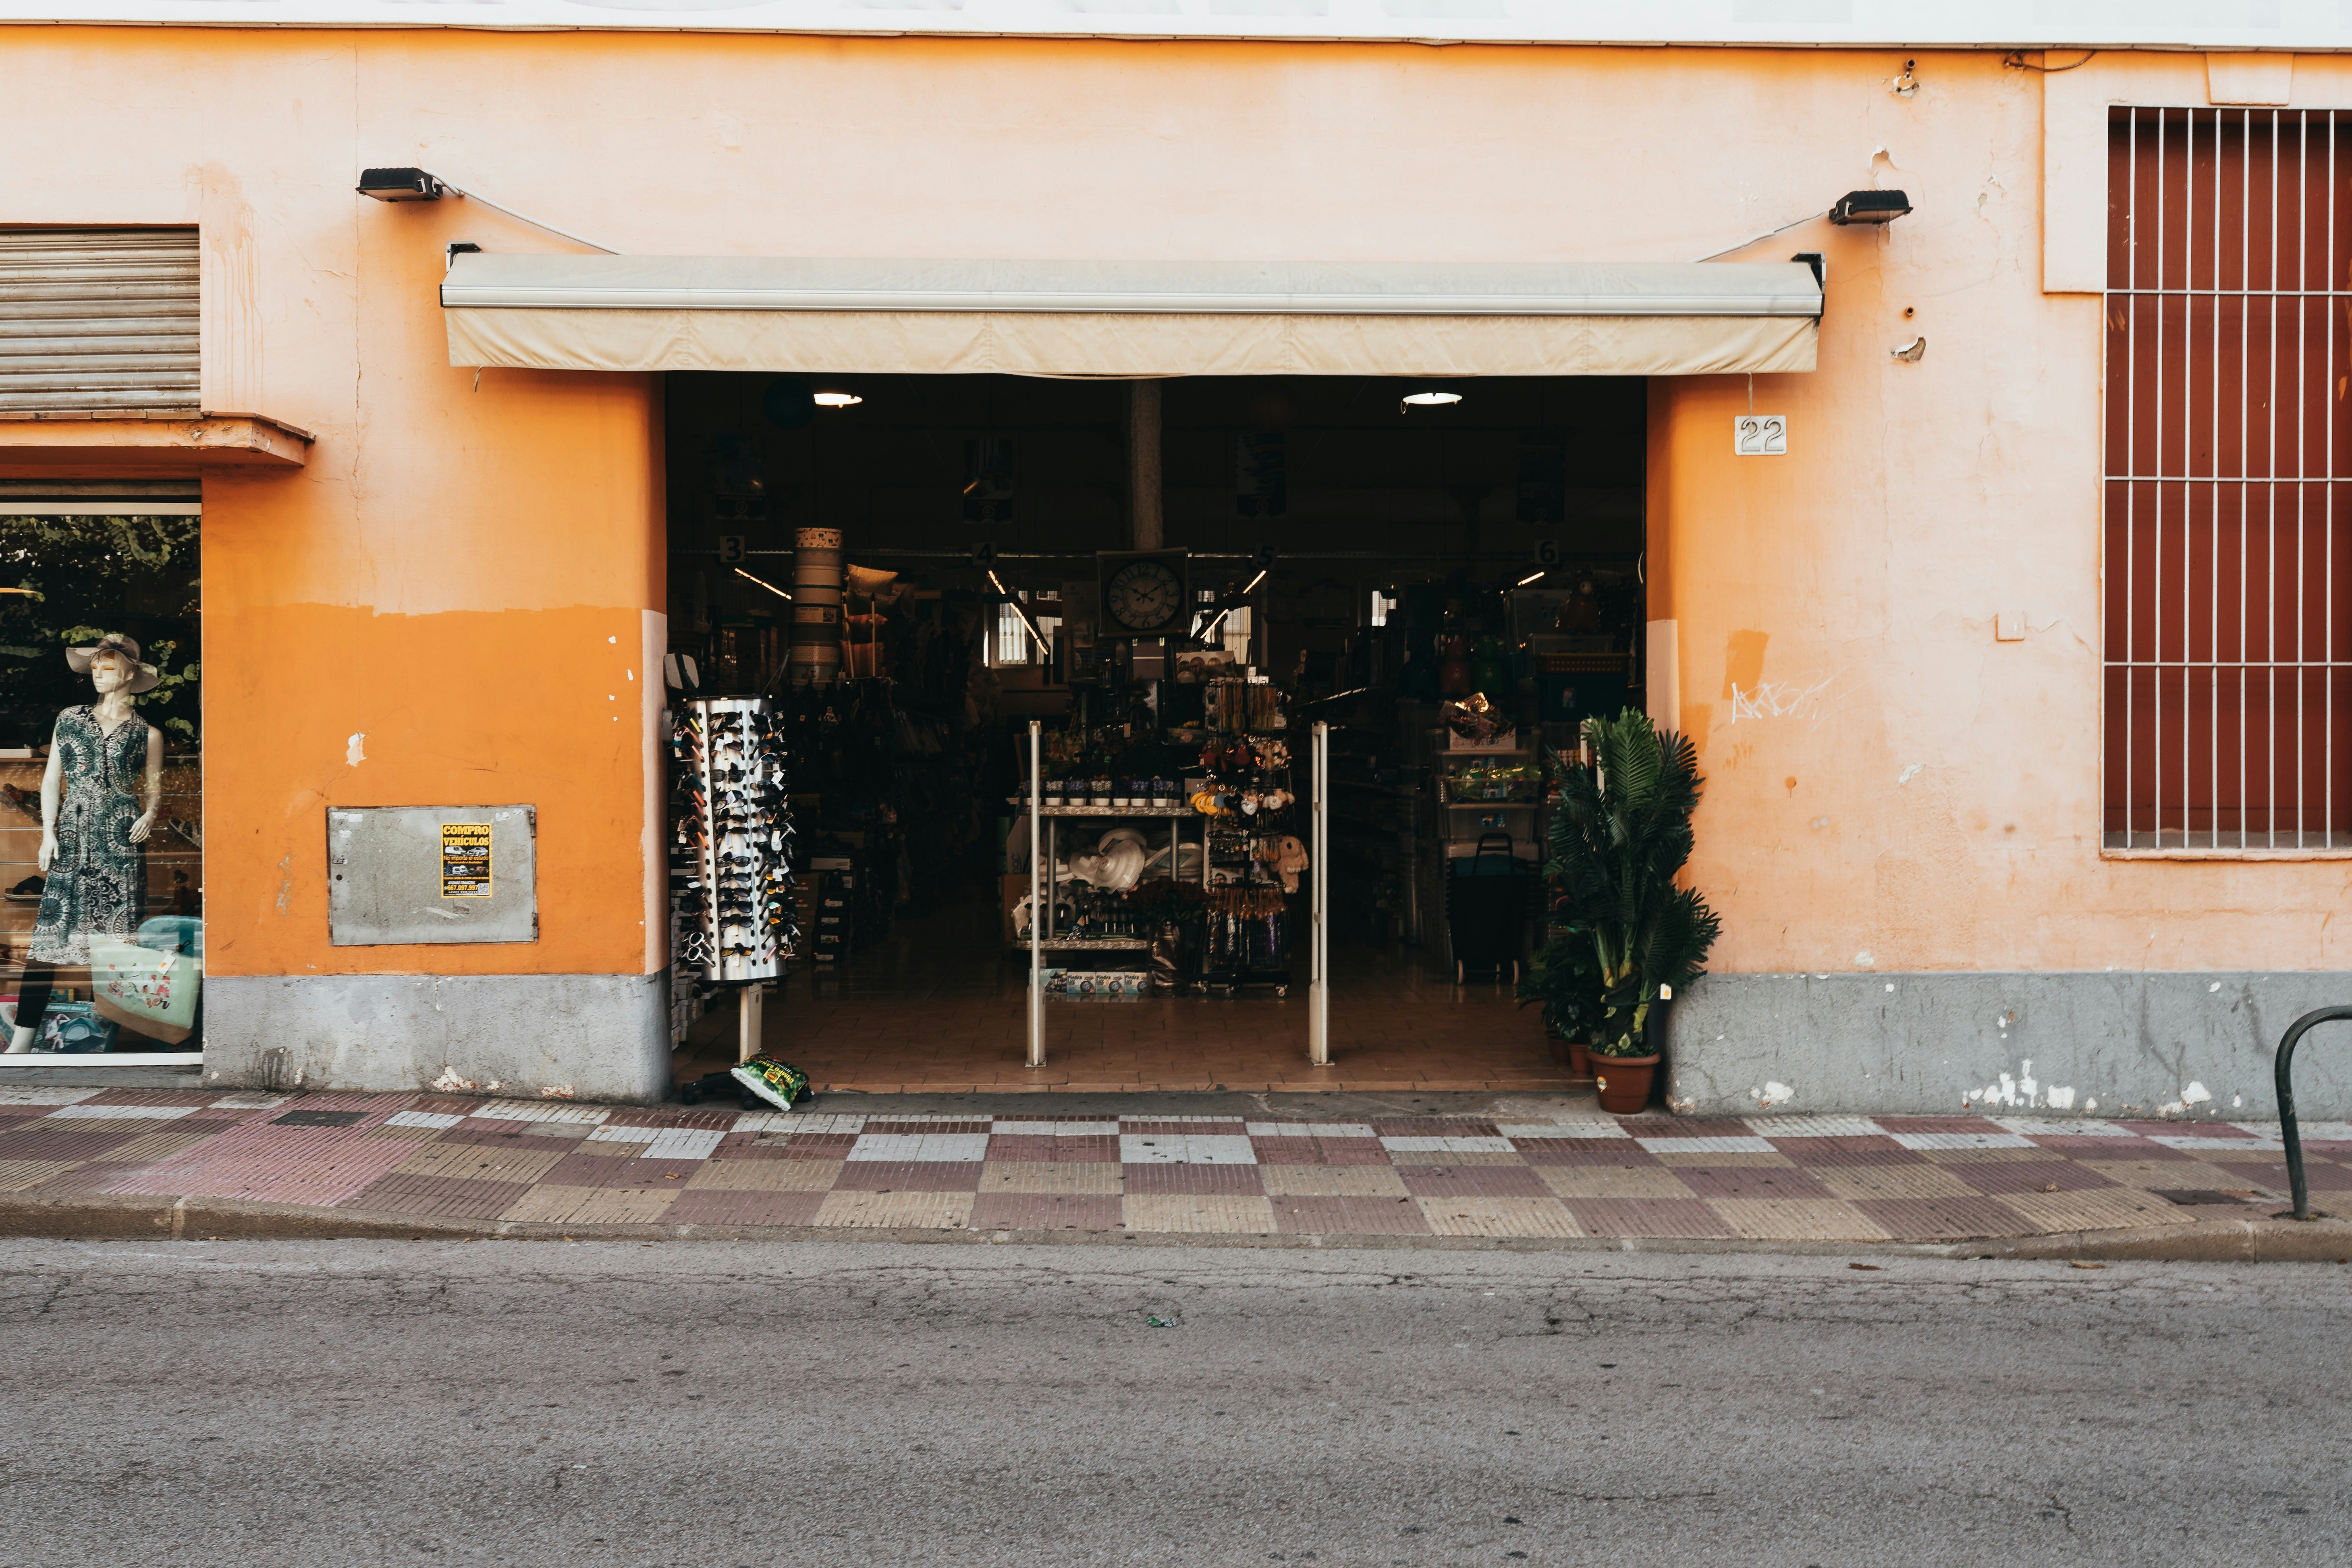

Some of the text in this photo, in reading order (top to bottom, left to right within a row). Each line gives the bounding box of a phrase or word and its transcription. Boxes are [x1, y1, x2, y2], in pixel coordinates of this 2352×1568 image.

[1741, 419, 1784, 452] 22
[726, 537, 741, 561] 3
[977, 543, 994, 564] 4
[1540, 541, 1555, 563] 6
[1257, 546, 1275, 566] 5
[1122, 568, 1135, 580] 11
[1136, 564, 1149, 575] 12
[1154, 567, 1161, 577] 1
[1162, 575, 1174, 584] 2
[1112, 579, 1125, 592] 10
[1115, 607, 1126, 617] 8
[1166, 603, 1175, 611] 4
[1127, 615, 1137, 626] 7
[1142, 618, 1150, 628] 6
[1155, 612, 1166, 623] 5
[444, 826, 489, 835] COMPRO
[444, 835, 489, 846] VEHÍCULOS
[774, 1067, 795, 1084] COMPO
